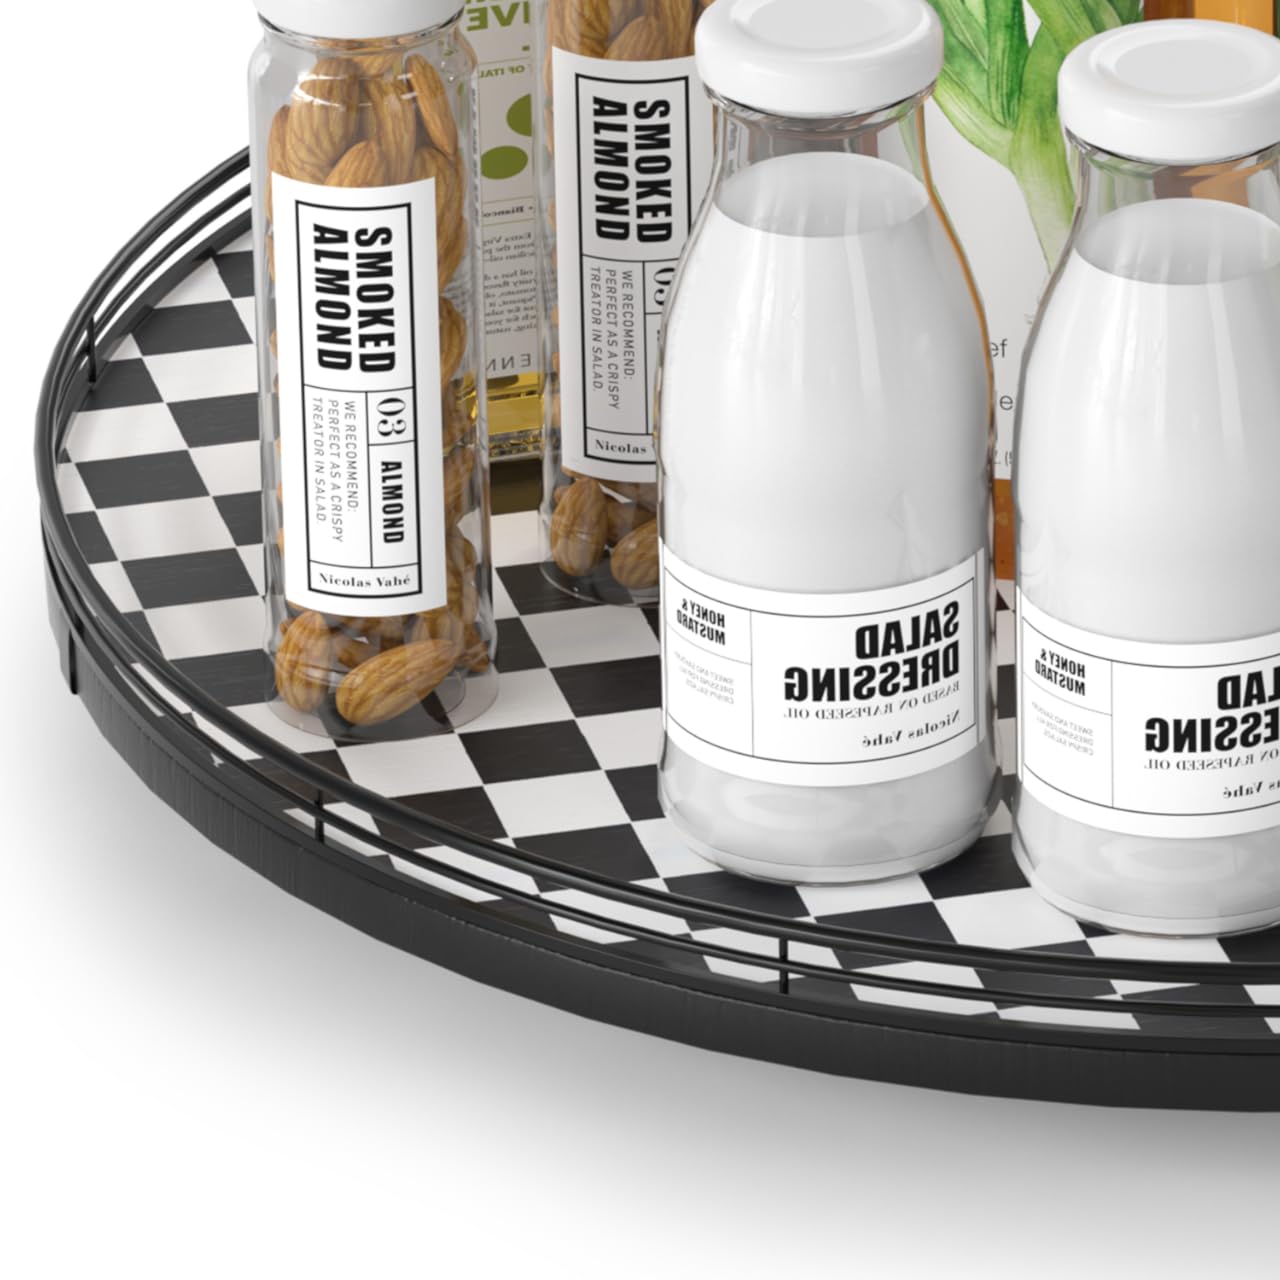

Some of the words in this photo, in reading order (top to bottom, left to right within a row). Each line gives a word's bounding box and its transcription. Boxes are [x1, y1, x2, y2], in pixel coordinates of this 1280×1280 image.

[592, 96, 630, 241] ALMOND
[633, 98, 672, 243] SMOKED
[312, 223, 352, 371] ALMOND
[355, 227, 396, 373] SMOKED
[590, 267, 602, 326] TREATOR
[605, 269, 618, 327] PERFECT
[622, 270, 633, 289] WE
[592, 329, 602, 342] IN
[607, 330, 618, 347] AS
[607, 351, 618, 359] A
[622, 293, 635, 380] RECOMMEND:
[608, 363, 620, 410] CRISPY
[312, 397, 325, 457] TREATOR
[328, 399, 341, 459] PERFECT
[344, 401, 356, 420] WE
[376, 396, 407, 437] 03
[314, 460, 326, 474] IN
[329, 461, 341, 479] AS
[345, 424, 359, 512] RECOMMEND:
[595, 439, 647, 456] Nicolas
[330, 482, 341, 491] A
[381, 460, 405, 545] ALMOND
[330, 495, 344, 543] CRISPY
[318, 572, 372, 589] Nicolas
[377, 572, 411, 589] Vahé
